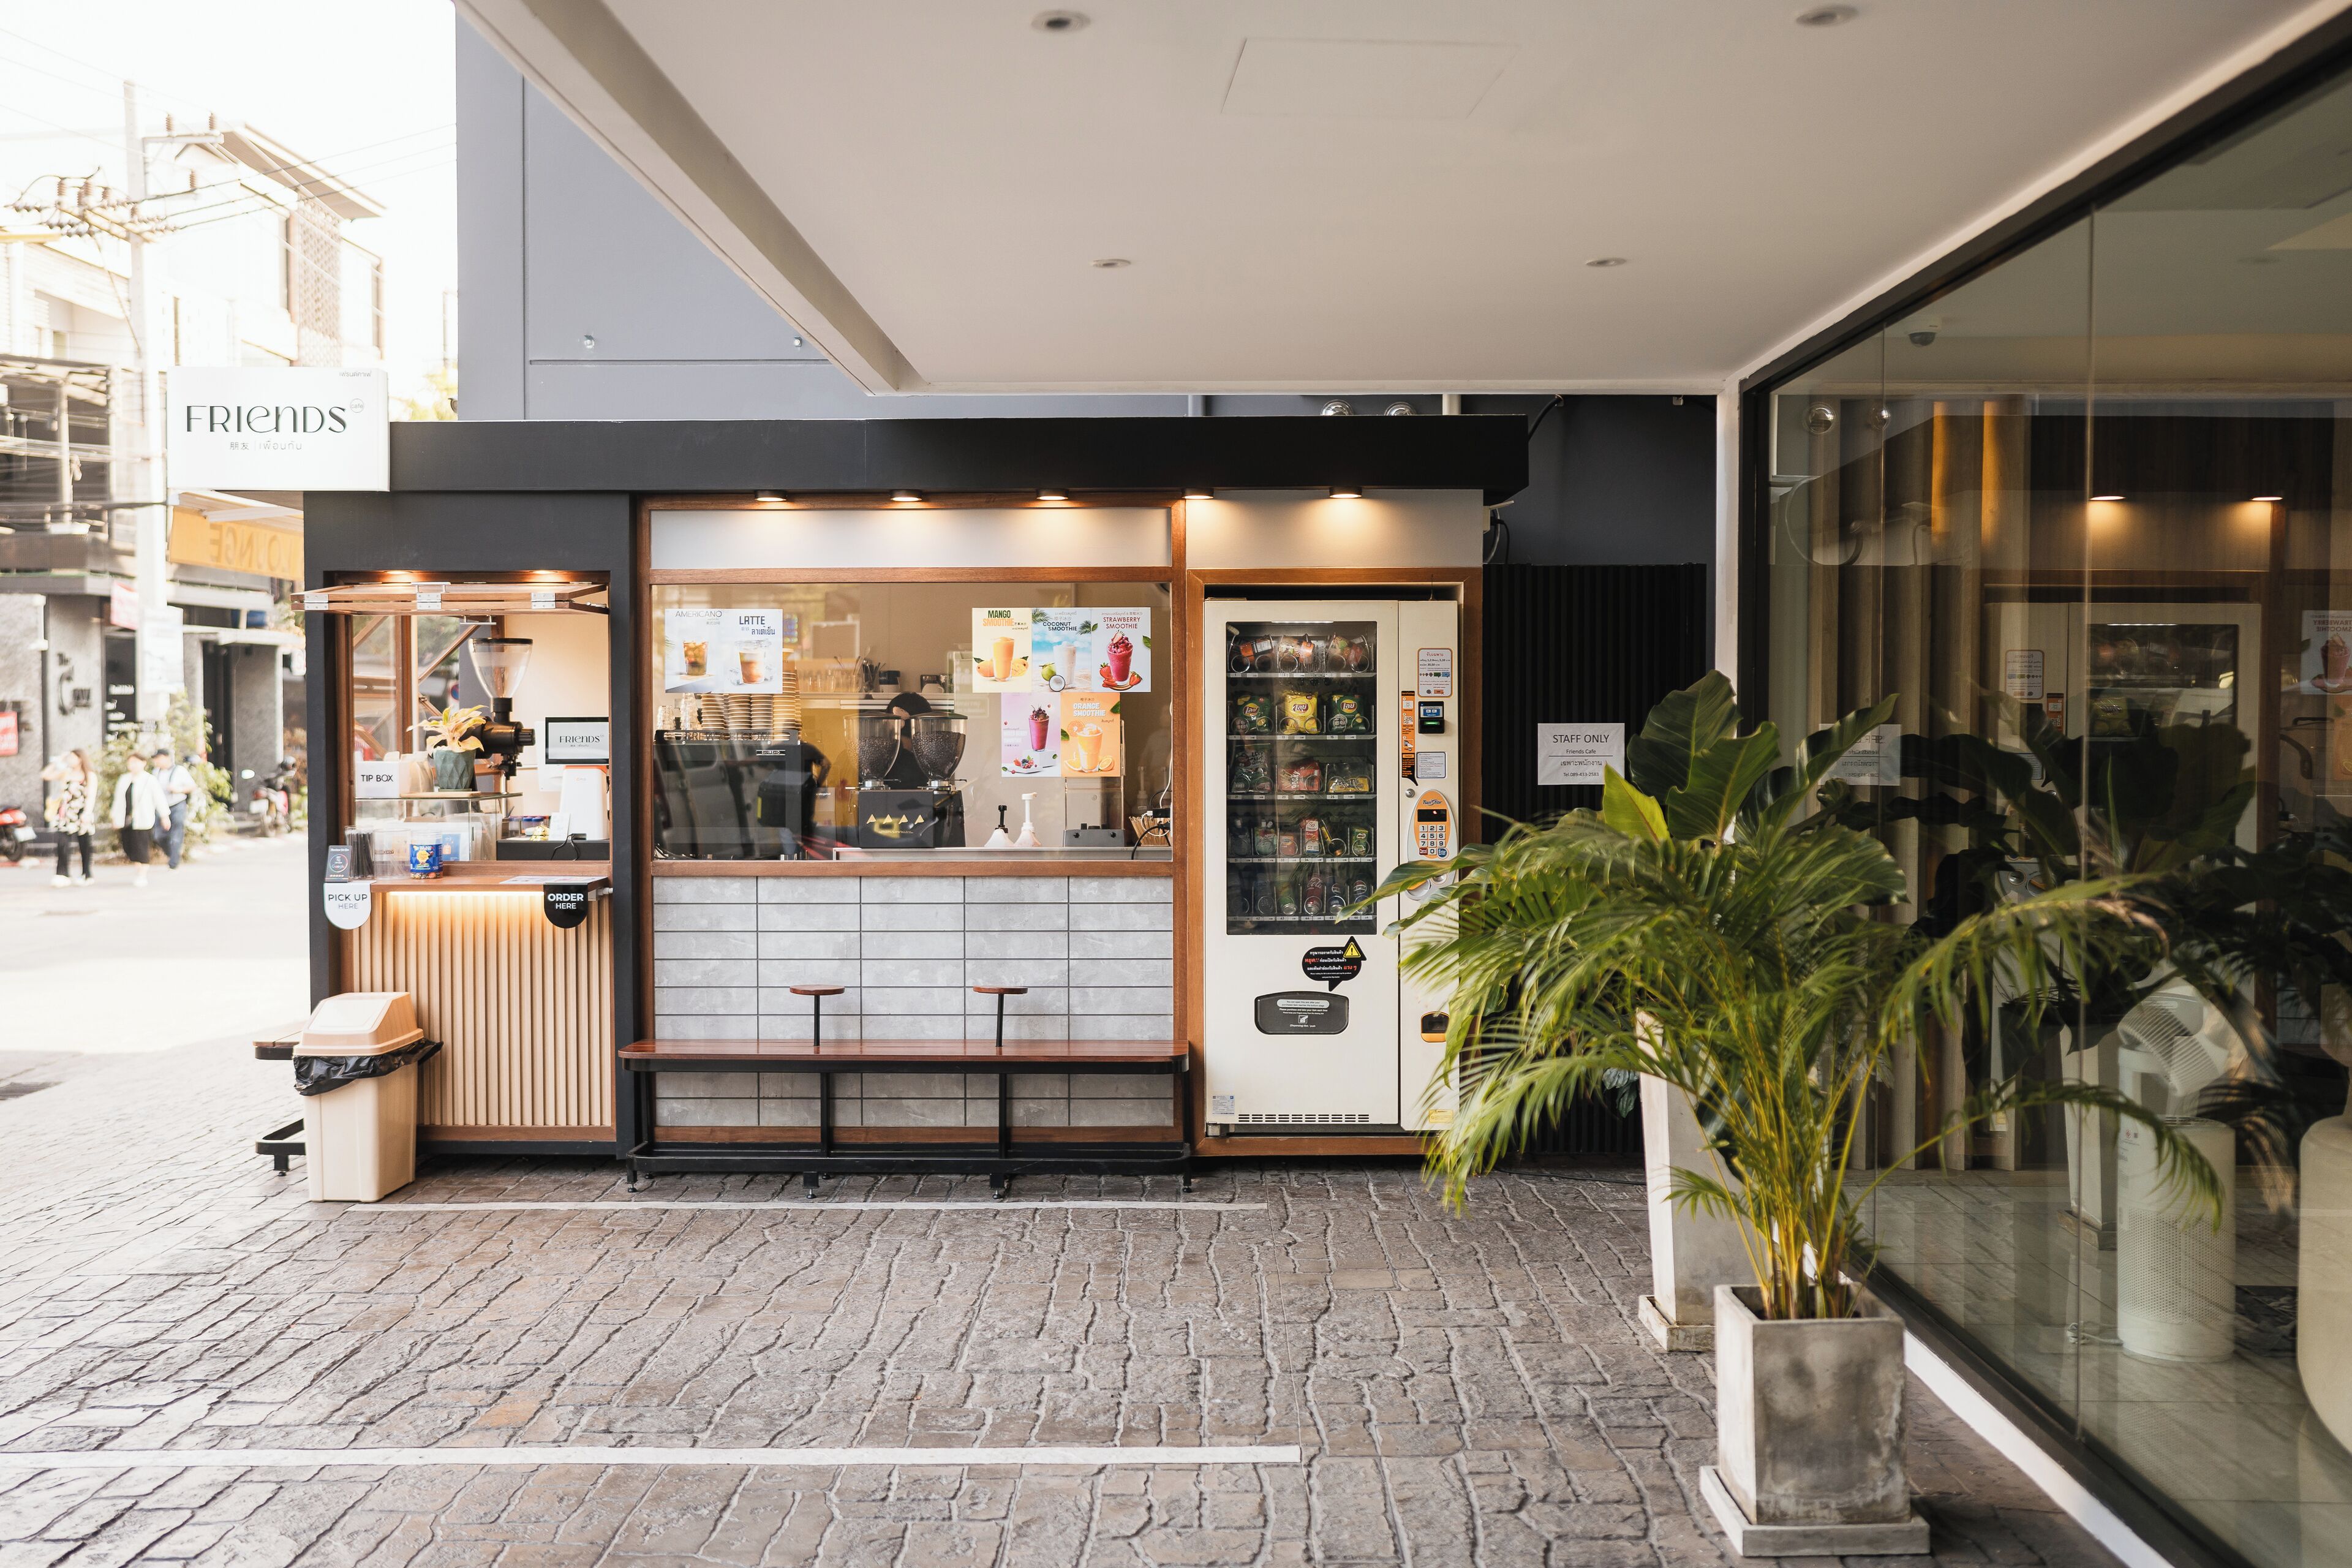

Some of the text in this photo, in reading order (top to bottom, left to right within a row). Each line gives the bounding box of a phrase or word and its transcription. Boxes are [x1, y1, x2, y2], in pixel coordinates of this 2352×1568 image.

[230, 442, 250, 450] 朋友
[739, 616, 766, 625] LATTE
[751, 625, 775, 635] ลาเต้เย็น
[1553, 734, 1610, 743] STAFF ONLY
[548, 893, 584, 902] ORDER
